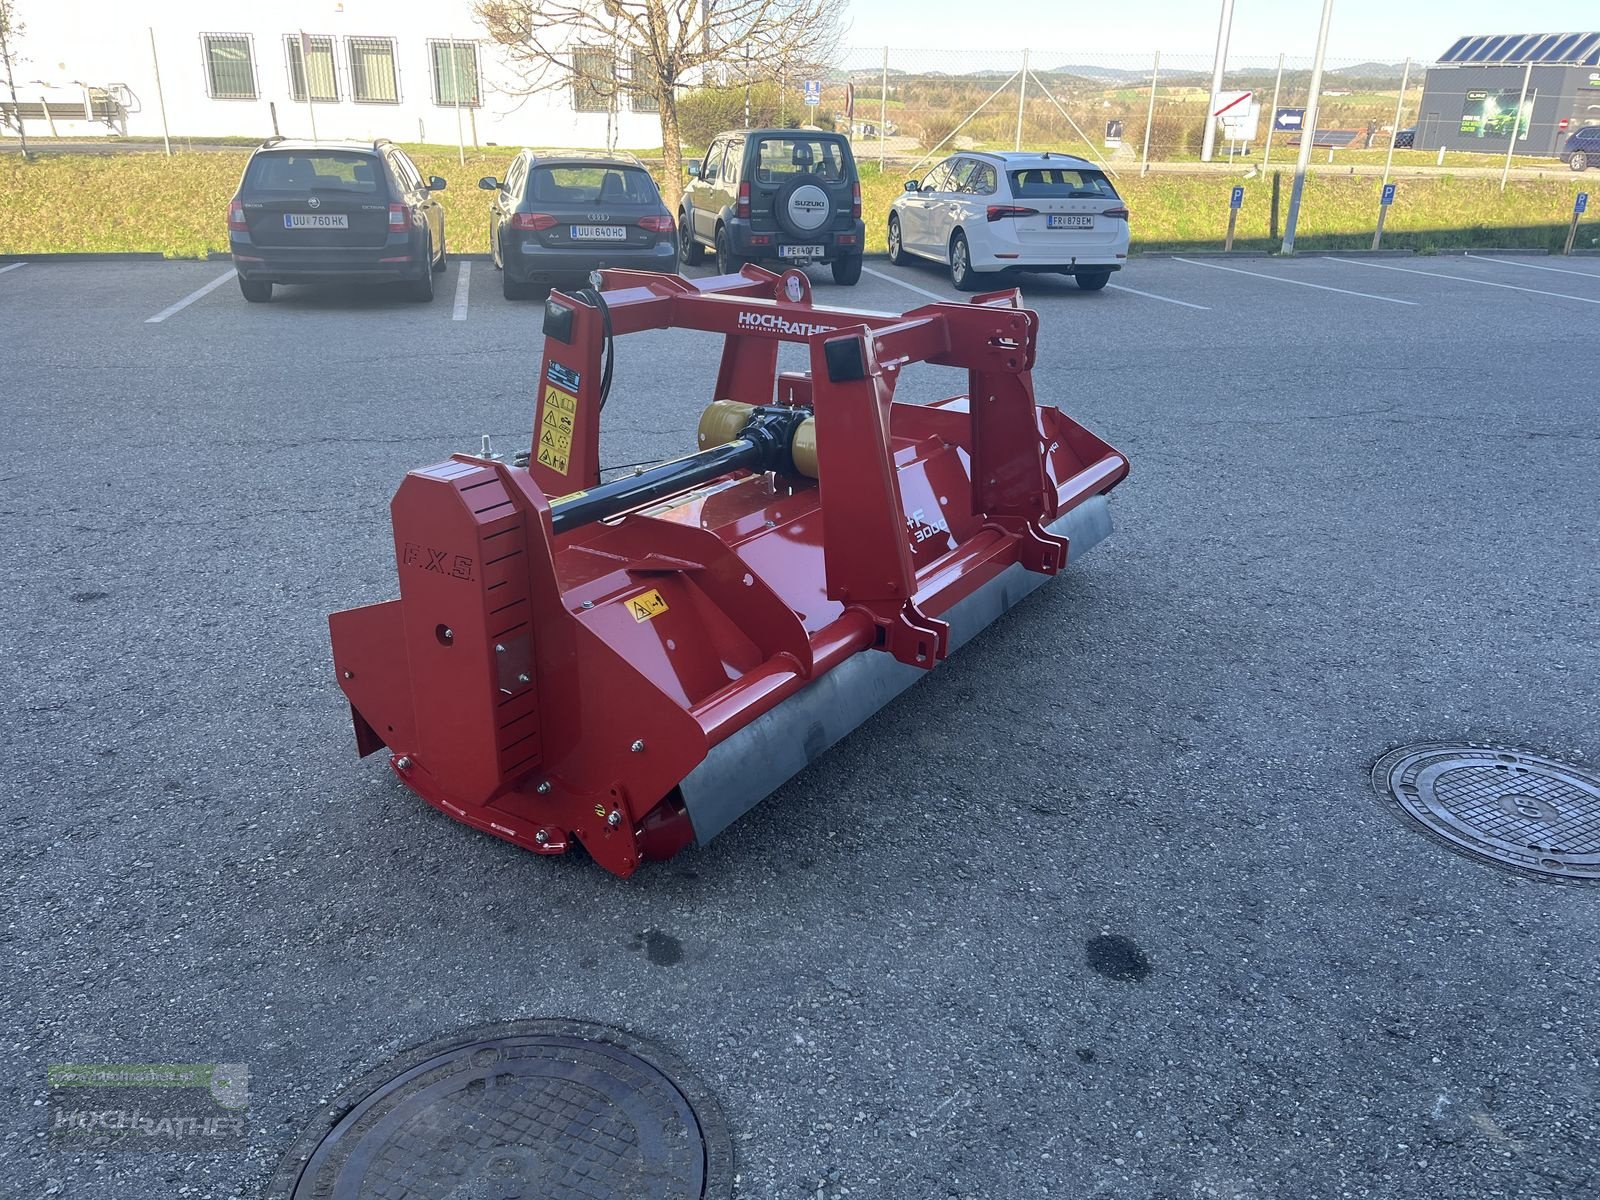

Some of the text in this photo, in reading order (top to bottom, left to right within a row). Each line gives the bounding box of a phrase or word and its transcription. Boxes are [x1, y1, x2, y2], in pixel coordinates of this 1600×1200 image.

[1233, 189, 1242, 201] P
[1385, 187, 1393, 198] P
[292, 216, 345, 226] UU 760 HK
[1053, 217, 1063, 225] FR
[1067, 217, 1081, 225] 879
[578, 227, 589, 237] UU
[595, 227, 611, 237] 640
[787, 247, 797, 255] PE
[914, 519, 948, 543] 3000
